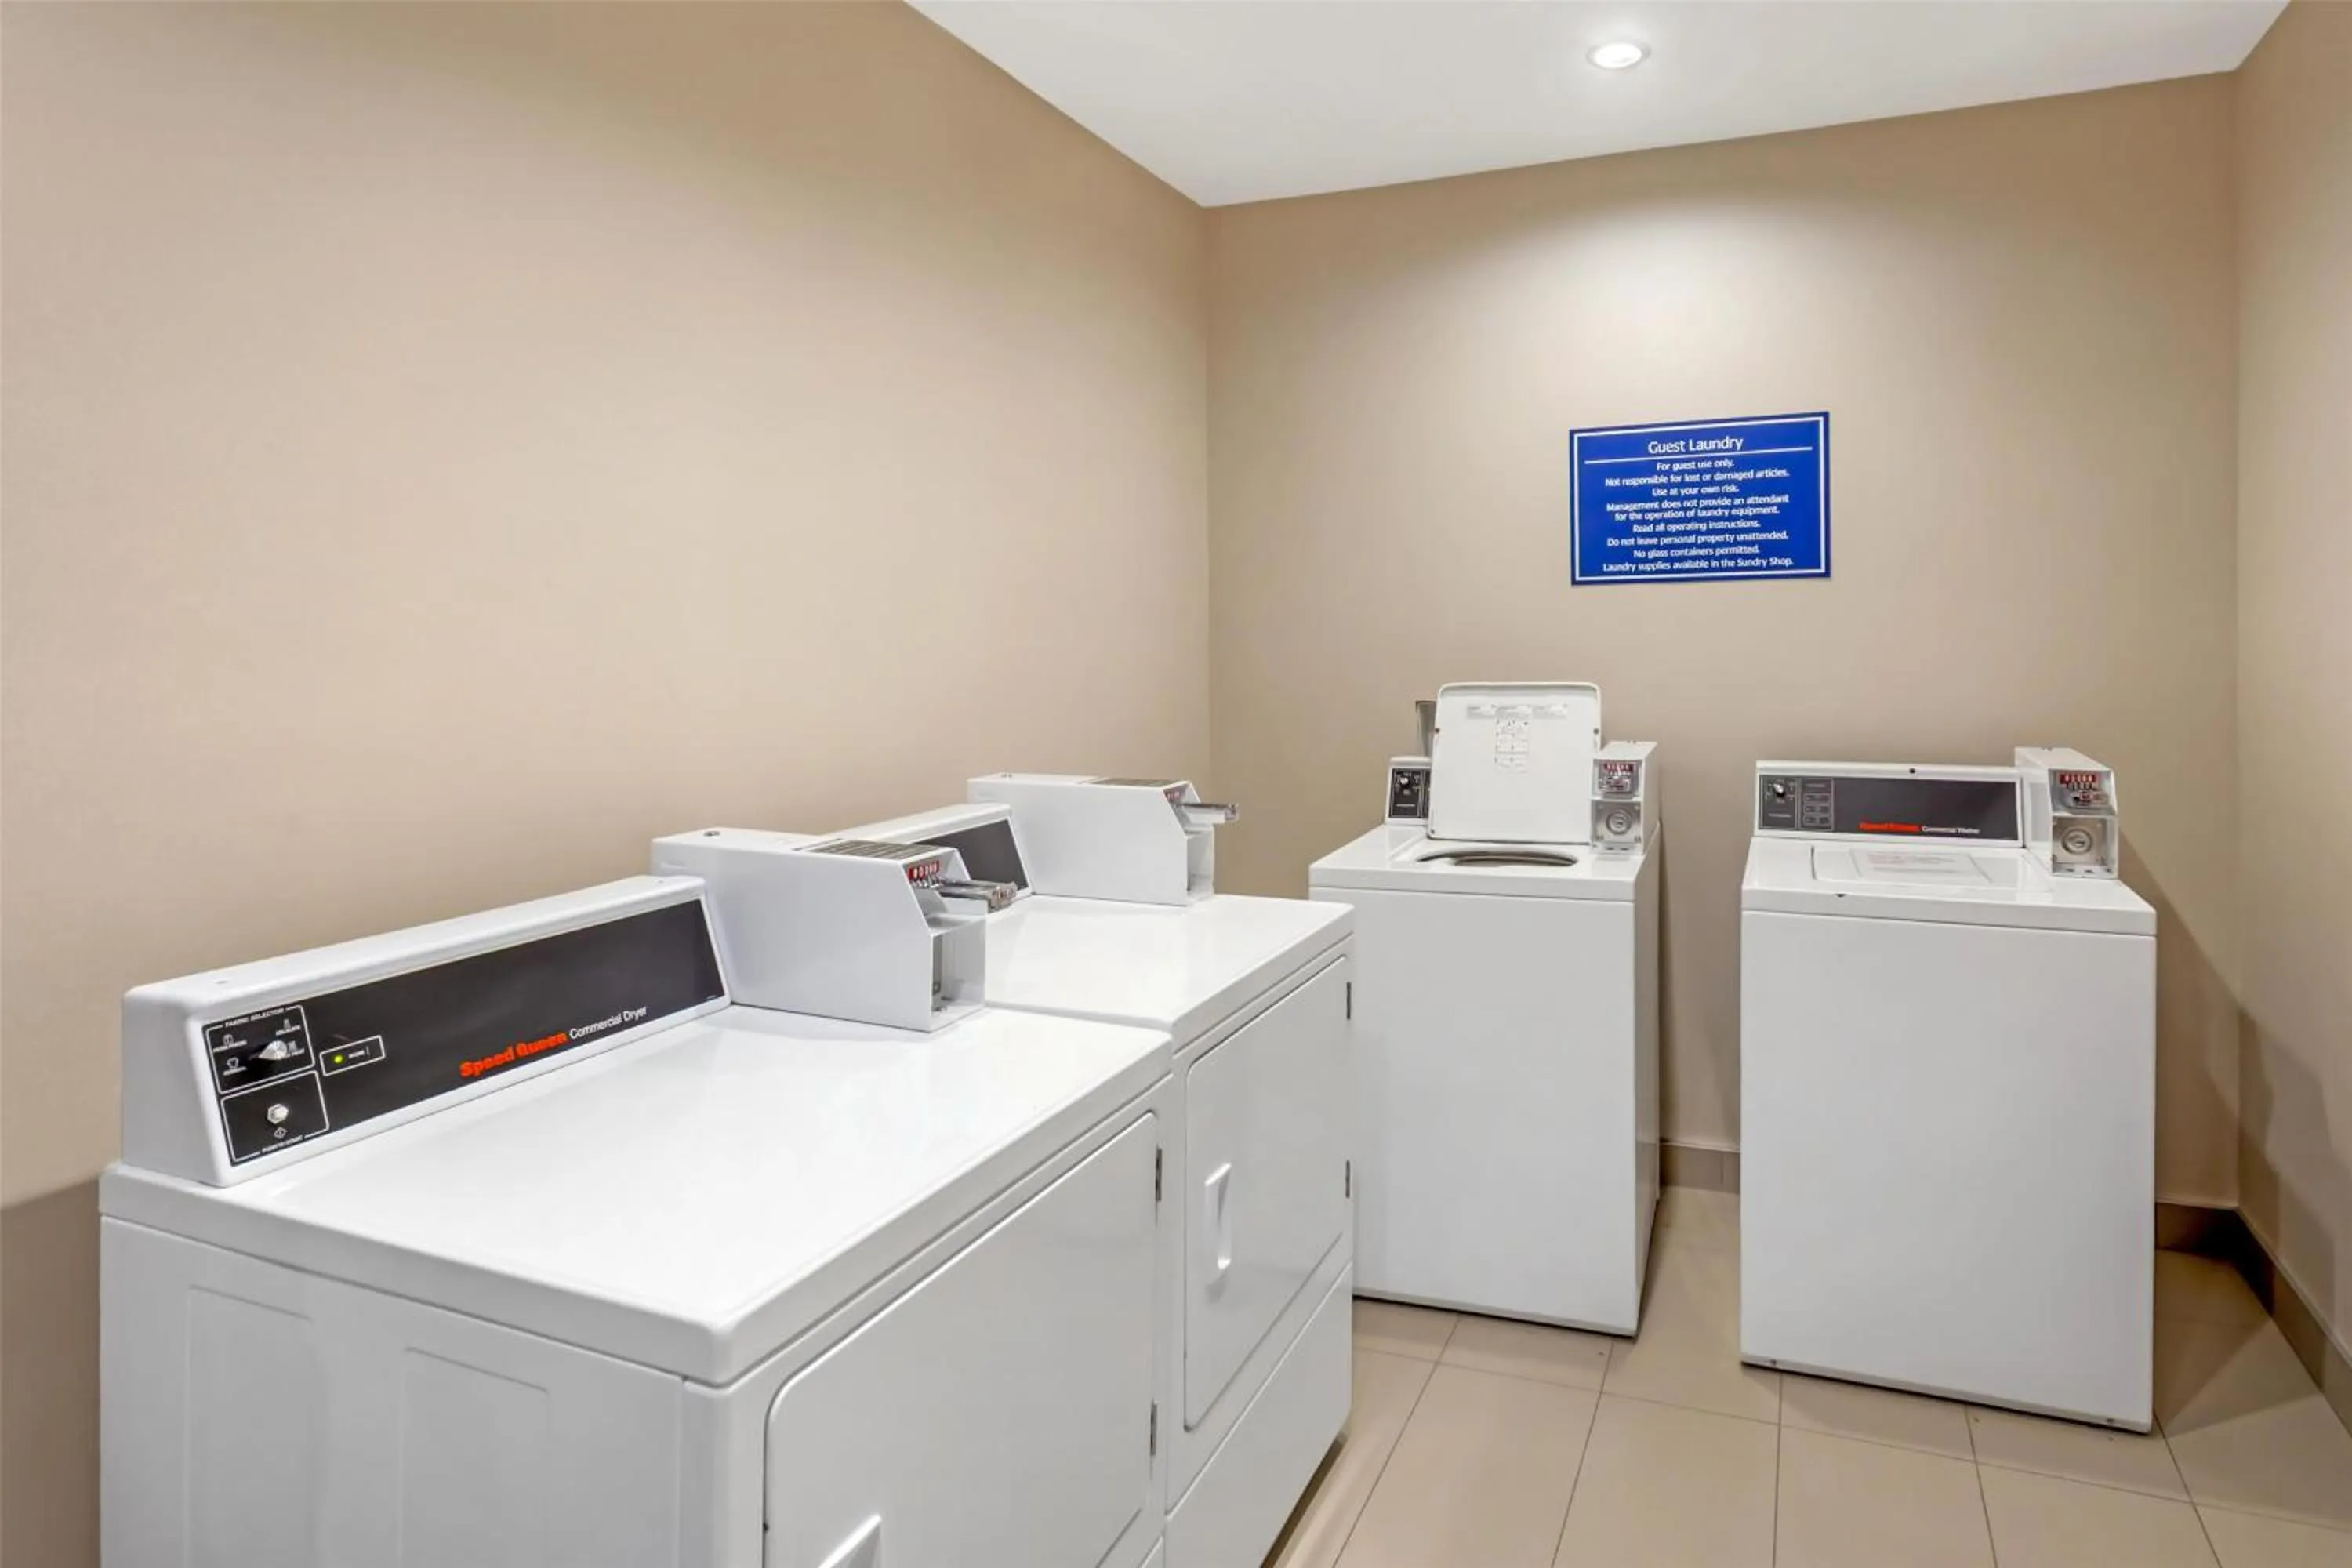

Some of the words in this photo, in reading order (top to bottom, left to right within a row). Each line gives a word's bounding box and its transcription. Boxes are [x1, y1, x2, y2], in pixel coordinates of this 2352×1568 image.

[1648, 441, 1686, 454] Guest
[1689, 435, 1744, 452] Laundry
[1657, 462, 1671, 471] For
[1672, 461, 1696, 471] guest
[1714, 459, 1735, 469] only.
[1605, 477, 1621, 487] Not
[1622, 474, 1668, 487] responsible
[1670, 474, 1682, 483] for
[1684, 473, 1700, 482] lost
[1714, 470, 1754, 481] damaged
[1755, 468, 1790, 478] articles.
[1652, 488, 1668, 496] Use
[1680, 487, 1700, 496] your
[1701, 485, 1720, 494] own
[1722, 484, 1740, 492] risk.
[1606, 501, 1659, 511] Management
[1661, 500, 1681, 509] does
[1700, 497, 1731, 507] provide
[1746, 494, 1789, 503] attendant
[1615, 512, 1627, 521] for
[1629, 511, 1642, 521] the
[1645, 510, 1684, 521] operation
[1697, 508, 1729, 517] laundry
[1731, 506, 1780, 516] equipment.
[1632, 524, 1653, 532] Read
[1655, 523, 1665, 532] all
[1667, 521, 1707, 532] operating
[1709, 519, 1761, 529] instructions.
[1607, 538, 1619, 546] Do
[1660, 535, 1696, 546] personal
[1697, 533, 1734, 543] property
[1737, 530, 1788, 542] unattended.
[1634, 550, 1646, 558] No
[1648, 549, 1668, 559] glass
[1670, 547, 1714, 557] containers
[1715, 545, 1760, 556] permitted.
[1603, 562, 1635, 572] Laundry
[1638, 561, 1671, 571] supplies
[1673, 560, 1709, 568] available
[1721, 558, 1735, 567] the
[1737, 557, 1767, 568] Sundry
[1769, 557, 1794, 567] Shop.
[459, 1047, 515, 1078] Speed
[516, 1031, 567, 1057] Queen
[569, 1014, 622, 1040] Commercial
[623, 1006, 648, 1022] Dryer
